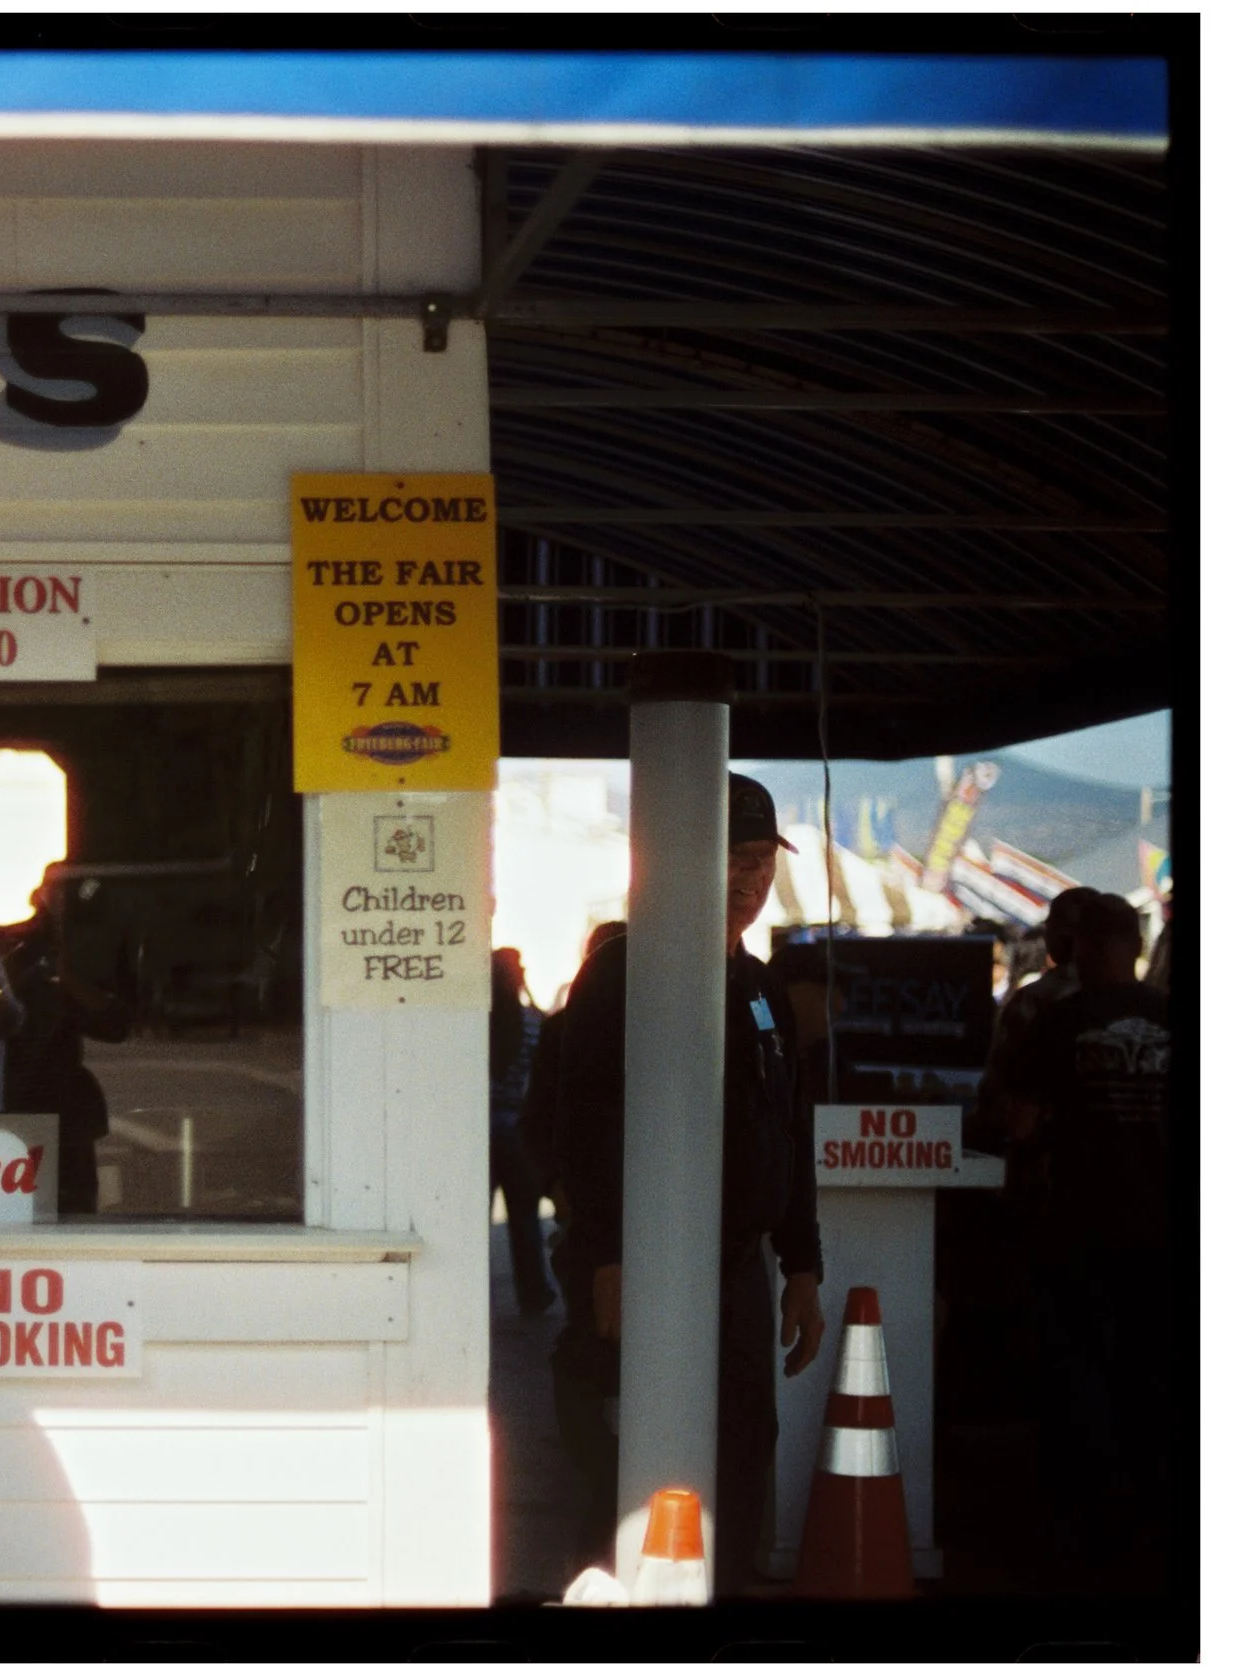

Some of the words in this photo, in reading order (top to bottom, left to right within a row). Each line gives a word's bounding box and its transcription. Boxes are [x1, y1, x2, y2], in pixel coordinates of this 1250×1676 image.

[300, 497, 488, 524] WELCOME
[307, 560, 384, 587] THE
[394, 560, 484, 587] FAIR
[334, 600, 457, 627] OPENS
[370, 641, 421, 667] AT
[351, 681, 373, 708] 7
[384, 681, 442, 708] AM
[341, 885, 466, 913] Children
[340, 920, 425, 946] under
[434, 919, 466, 946] 12
[364, 954, 445, 981] FREE
[860, 1109, 917, 1138] NO
[824, 1140, 952, 1169] SMOKING
